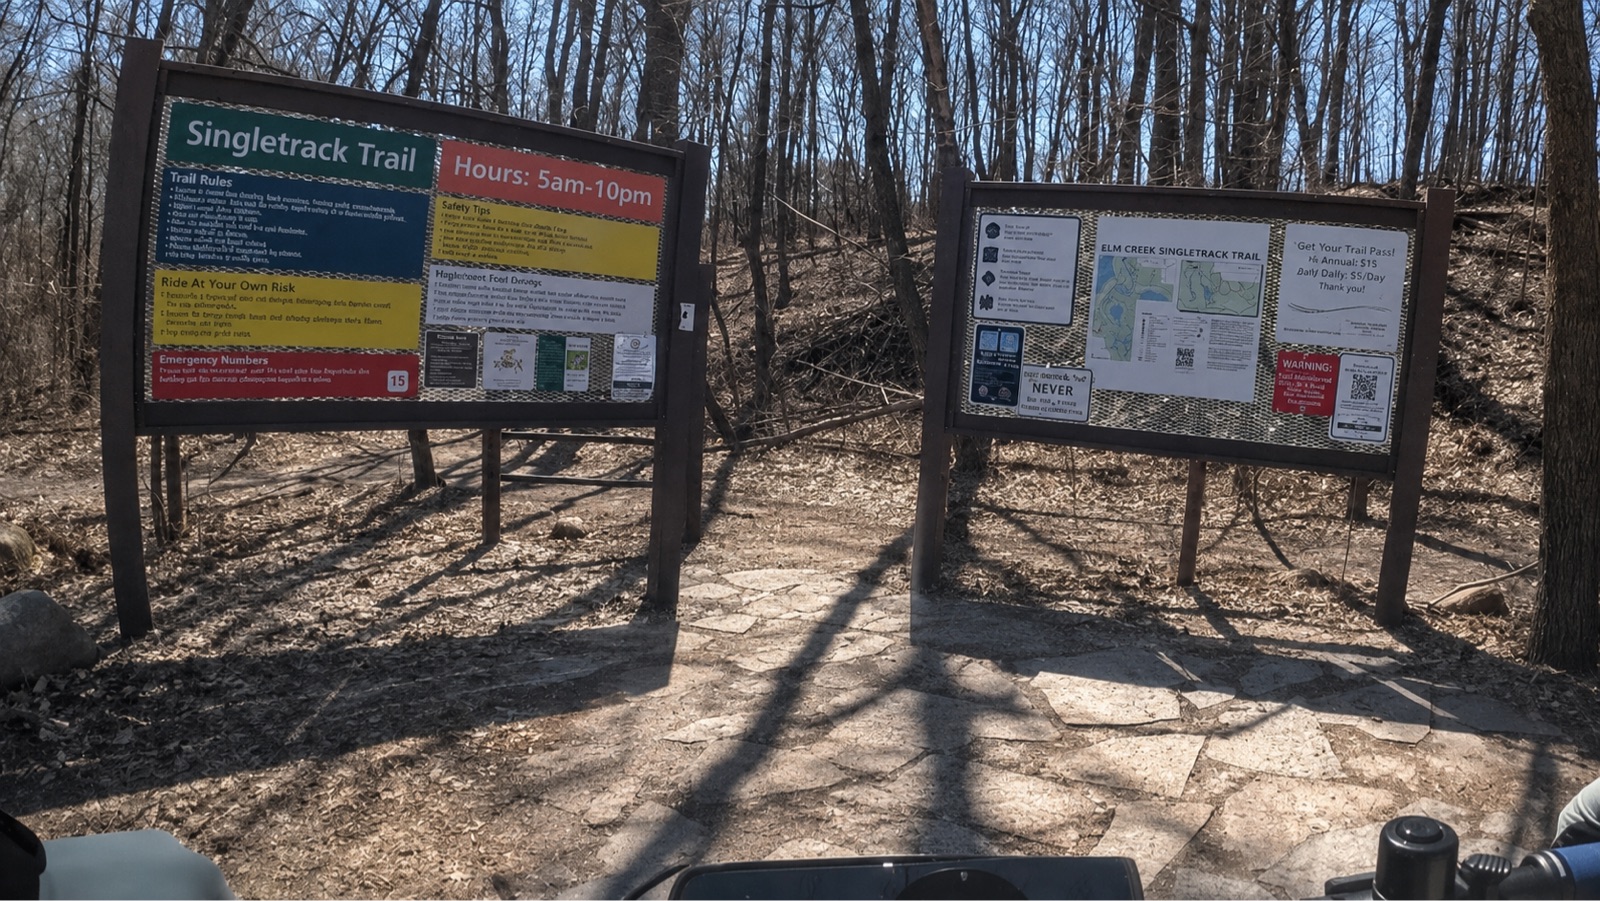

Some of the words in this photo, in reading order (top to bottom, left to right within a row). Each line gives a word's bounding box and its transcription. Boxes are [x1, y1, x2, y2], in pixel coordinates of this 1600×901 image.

[186, 119, 349, 163] Singletrack
[358, 142, 417, 172] Trail
[170, 171, 196, 185] Trail
[199, 173, 233, 188] Rules
[454, 155, 530, 186] Hours:
[537, 169, 652, 207] 5am-10pm
[441, 200, 470, 215] Safety
[472, 203, 491, 216] Tips
[1101, 244, 1122, 253] ELM
[1124, 245, 1156, 255] CREEK
[1159, 247, 1229, 259] SINGLETRACK
[1231, 250, 1261, 261] TRAIL
[1297, 241, 1316, 251] Get
[1319, 243, 1342, 253] Your
[1345, 244, 1367, 255] Trail
[1369, 246, 1395, 257] Pass!
[1321, 256, 1358, 267] Annual:
[161, 276, 188, 289] Ride
[191, 277, 206, 289] At
[208, 279, 236, 290] Your
[240, 280, 268, 292] Own
[271, 281, 296, 293] Risk
[1319, 282, 1344, 291] Thank
[1346, 285, 1366, 294] you!
[159, 355, 218, 367] Emergency
[221, 355, 269, 366] Numbers
[1282, 359, 1333, 372] WARNING:
[390, 375, 405, 387] 15
[1032, 383, 1073, 396] NEVER
